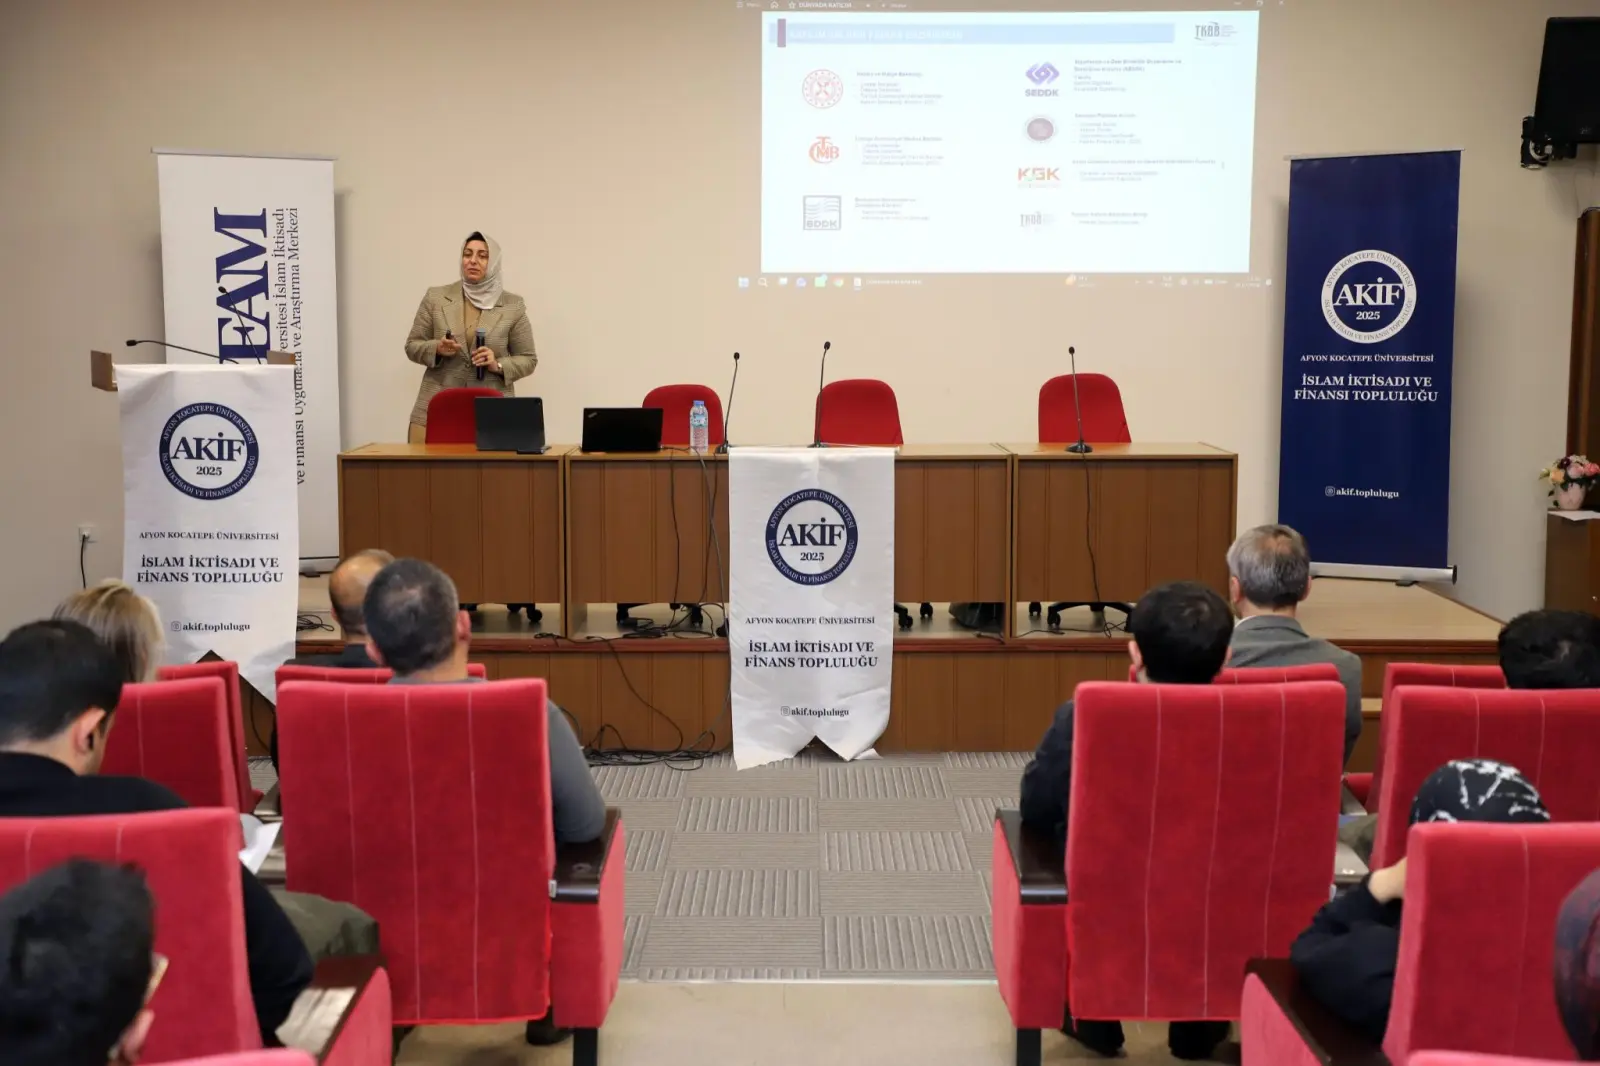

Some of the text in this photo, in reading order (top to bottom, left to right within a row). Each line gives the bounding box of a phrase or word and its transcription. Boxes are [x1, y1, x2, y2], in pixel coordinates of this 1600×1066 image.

[286, 208, 300, 260] Merkezi
[271, 208, 289, 352] ersitesi İslam İktisadı
[289, 264, 304, 330] Araştırma
[1333, 277, 1403, 306] AKİF
[1356, 311, 1381, 320] 2025
[293, 332, 302, 348] ve
[1300, 353, 1434, 362] AFYON KOCATEPE ÜNİVERSİTESİ
[1302, 373, 1432, 387] İSLAM İKTİSADI VE
[1294, 387, 1438, 401] FİNANSI TOPLULUĞU
[171, 431, 245, 462] AKİF
[196, 466, 222, 476] 2025
[1336, 487, 1399, 499] akif.toplulugu
[139, 531, 279, 540] AFYON KOCATEPE ÜNİVERSİTESİ
[779, 517, 845, 547] AKİF
[141, 554, 279, 568] İSLAM İKTİSADI VE
[800, 552, 824, 561] 2025
[137, 570, 283, 583] FİNANS TOPLULUĞU
[182, 621, 250, 632] akif.toplulugu
[775, 617, 817, 625] KOCATEPE
[819, 616, 875, 624] ÜNİVERSİTESİ
[749, 639, 874, 653] İSLAM İKTİSADI VE
[745, 655, 878, 668] FİNANS TOPLULUĞU
[791, 707, 849, 717] akif.toplulugu
